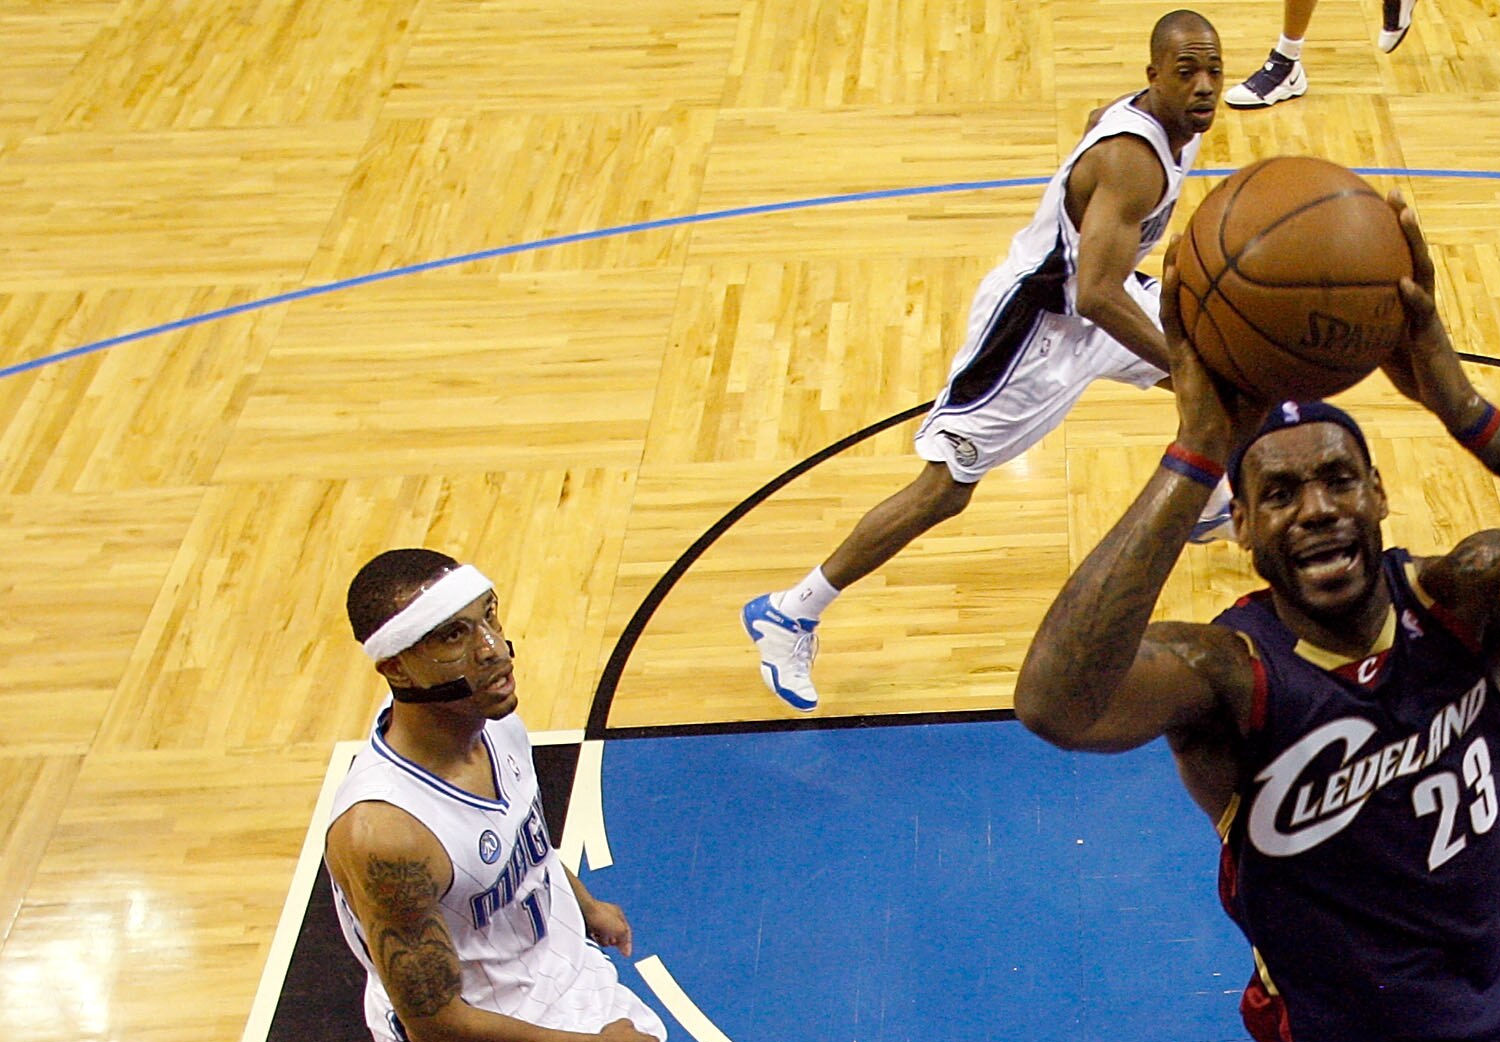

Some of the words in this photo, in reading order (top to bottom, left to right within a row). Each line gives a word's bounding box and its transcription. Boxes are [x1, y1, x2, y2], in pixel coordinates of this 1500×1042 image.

[1357, 656, 1377, 684] C
[1247, 677, 1487, 857] CLEVELAND
[1411, 736, 1499, 873] 23
